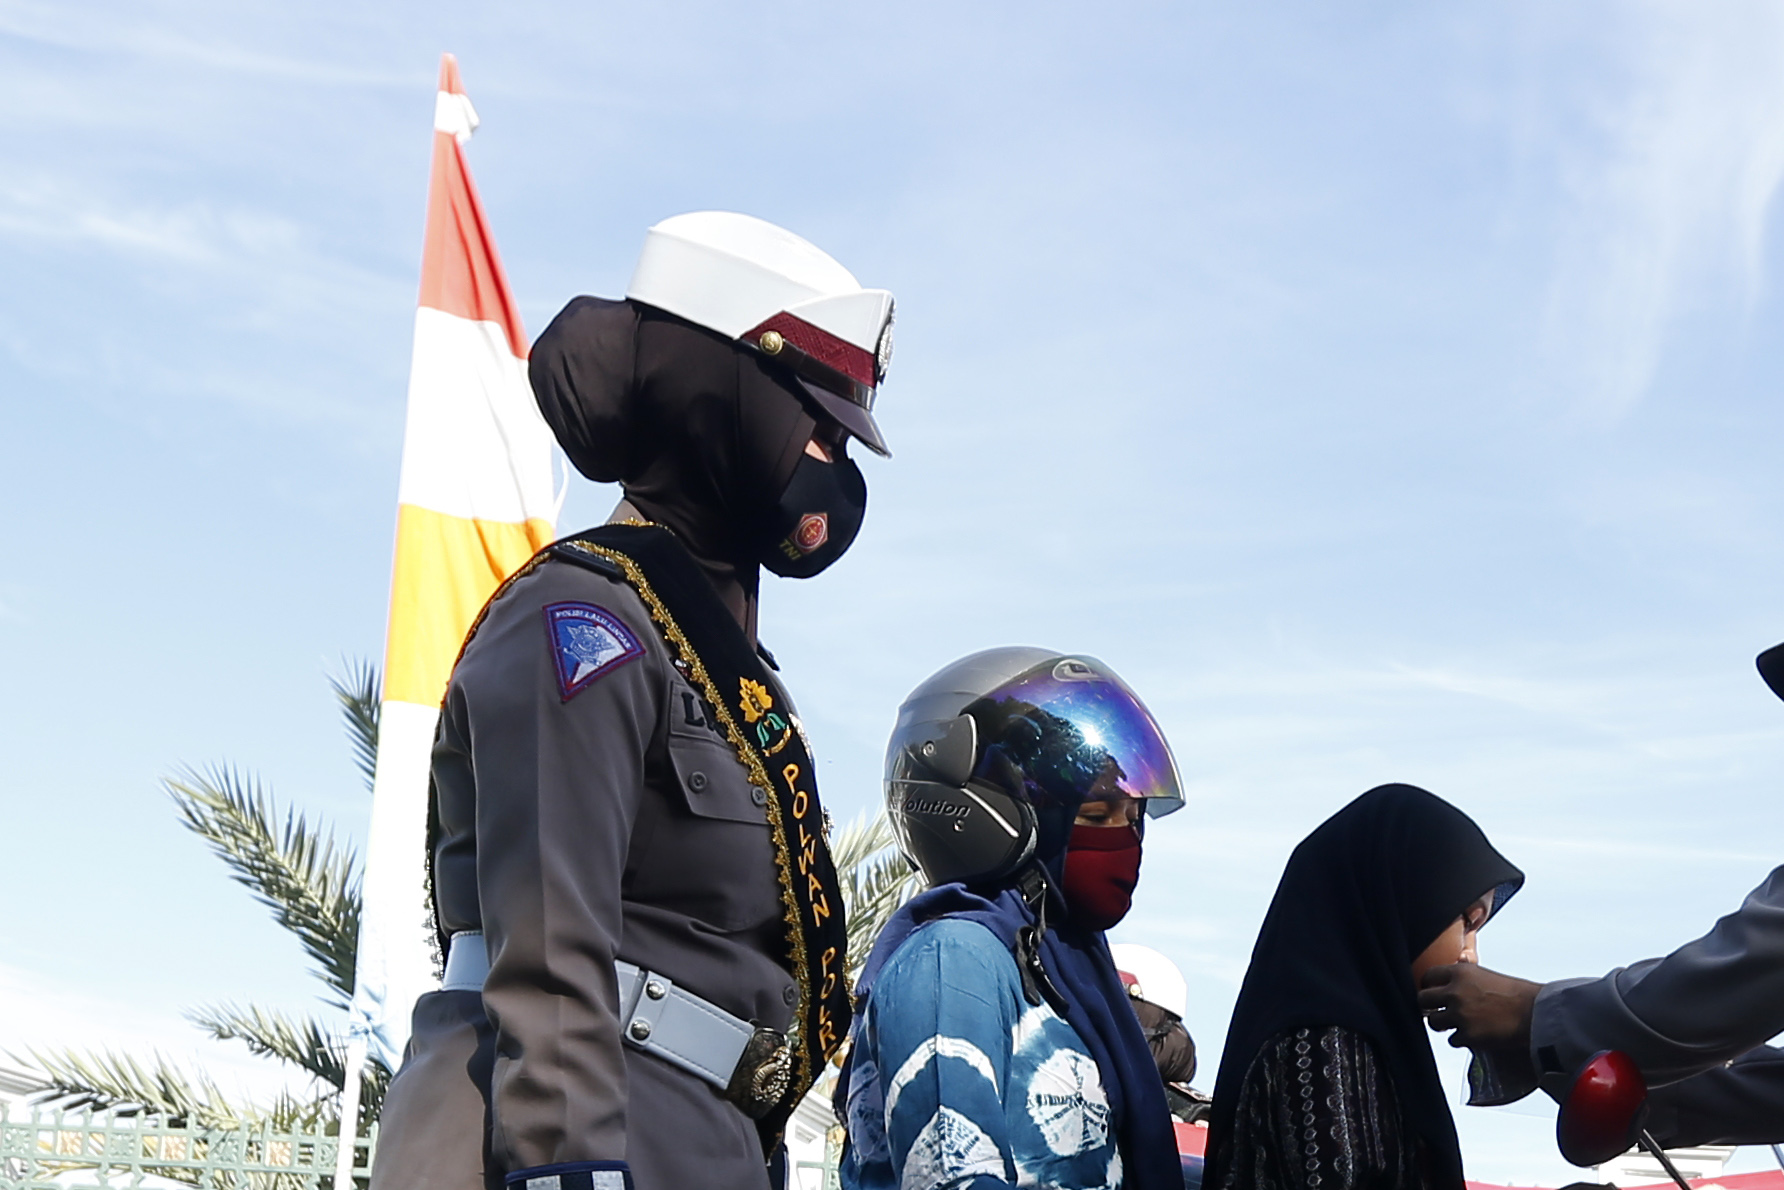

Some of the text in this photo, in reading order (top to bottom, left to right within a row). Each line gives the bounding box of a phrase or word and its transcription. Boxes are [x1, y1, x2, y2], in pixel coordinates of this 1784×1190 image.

[779, 538, 802, 561] TNI
[903, 800, 971, 817] olution
[782, 763, 830, 927] POLWAN
